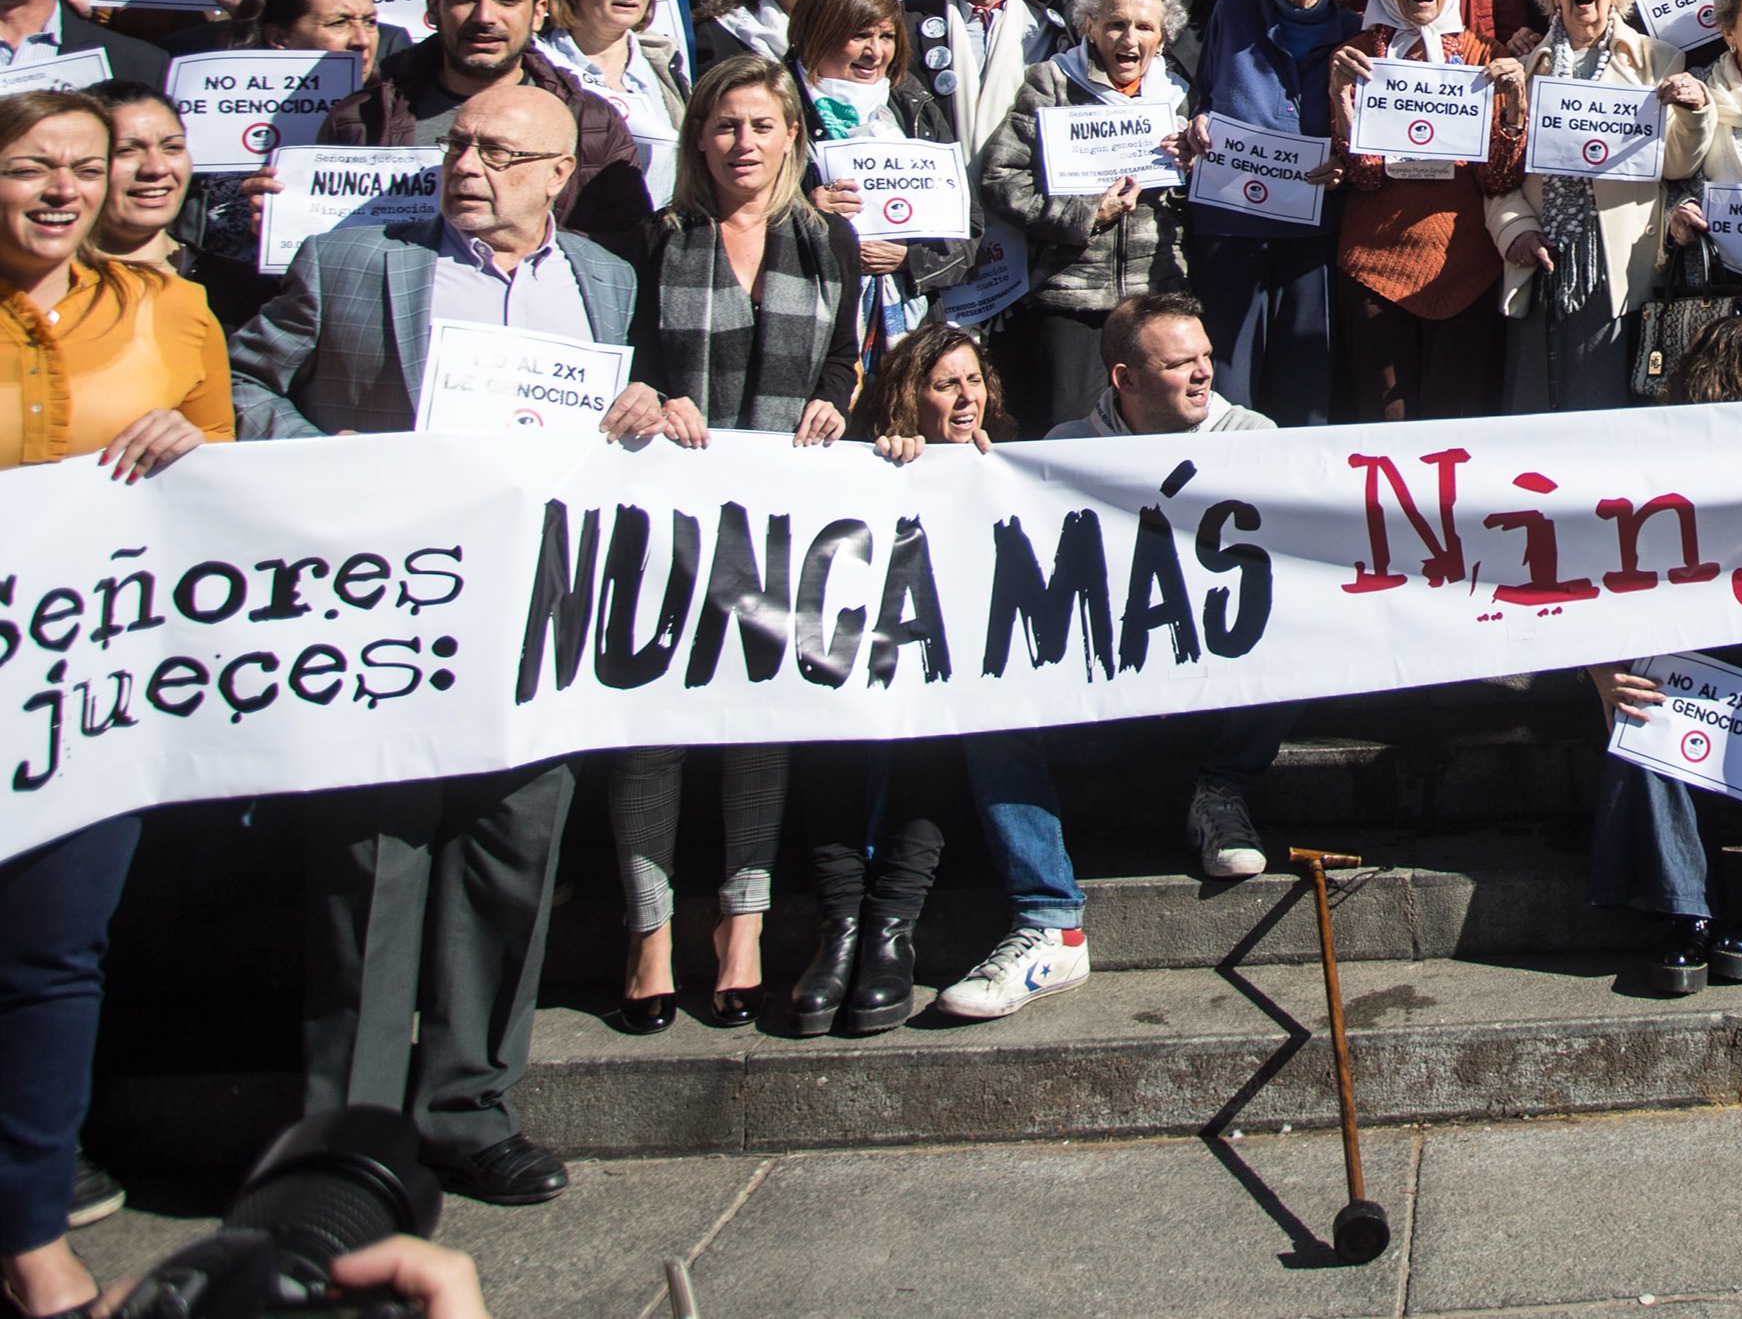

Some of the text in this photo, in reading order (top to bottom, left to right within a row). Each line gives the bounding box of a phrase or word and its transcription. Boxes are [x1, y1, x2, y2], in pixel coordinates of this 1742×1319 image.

[1652, 5, 1672, 19] DE
[205, 75, 320, 91] NO AL 2X1
[1386, 79, 1464, 97] NO AL 2X1
[179, 99, 339, 115] DE GENOCIDAS
[1366, 96, 1479, 117] DE GENOCIDAS
[1560, 98, 1639, 117] NO AL 2X1
[1070, 115, 1151, 141] NUNCA MÁS
[1542, 115, 1654, 137] DE GENOCIDAS
[314, 153, 366, 166] Señores
[1224, 137, 1299, 165] NO AL 2X1
[853, 157, 936, 170] NO AL 2X1
[1207, 151, 1311, 182] DE GENOCIDAS
[310, 166, 437, 197] NUNCA MÁS
[310, 203, 436, 218] Ningún genocida
[1712, 220, 1731, 233] DE
[553, 362, 586, 383] 2X1
[516, 459, 1275, 706] NUNCA MÁS
[1667, 671, 1694, 691] NO
[1697, 683, 1720, 702] AL
[13, 636, 459, 793] jueces:
